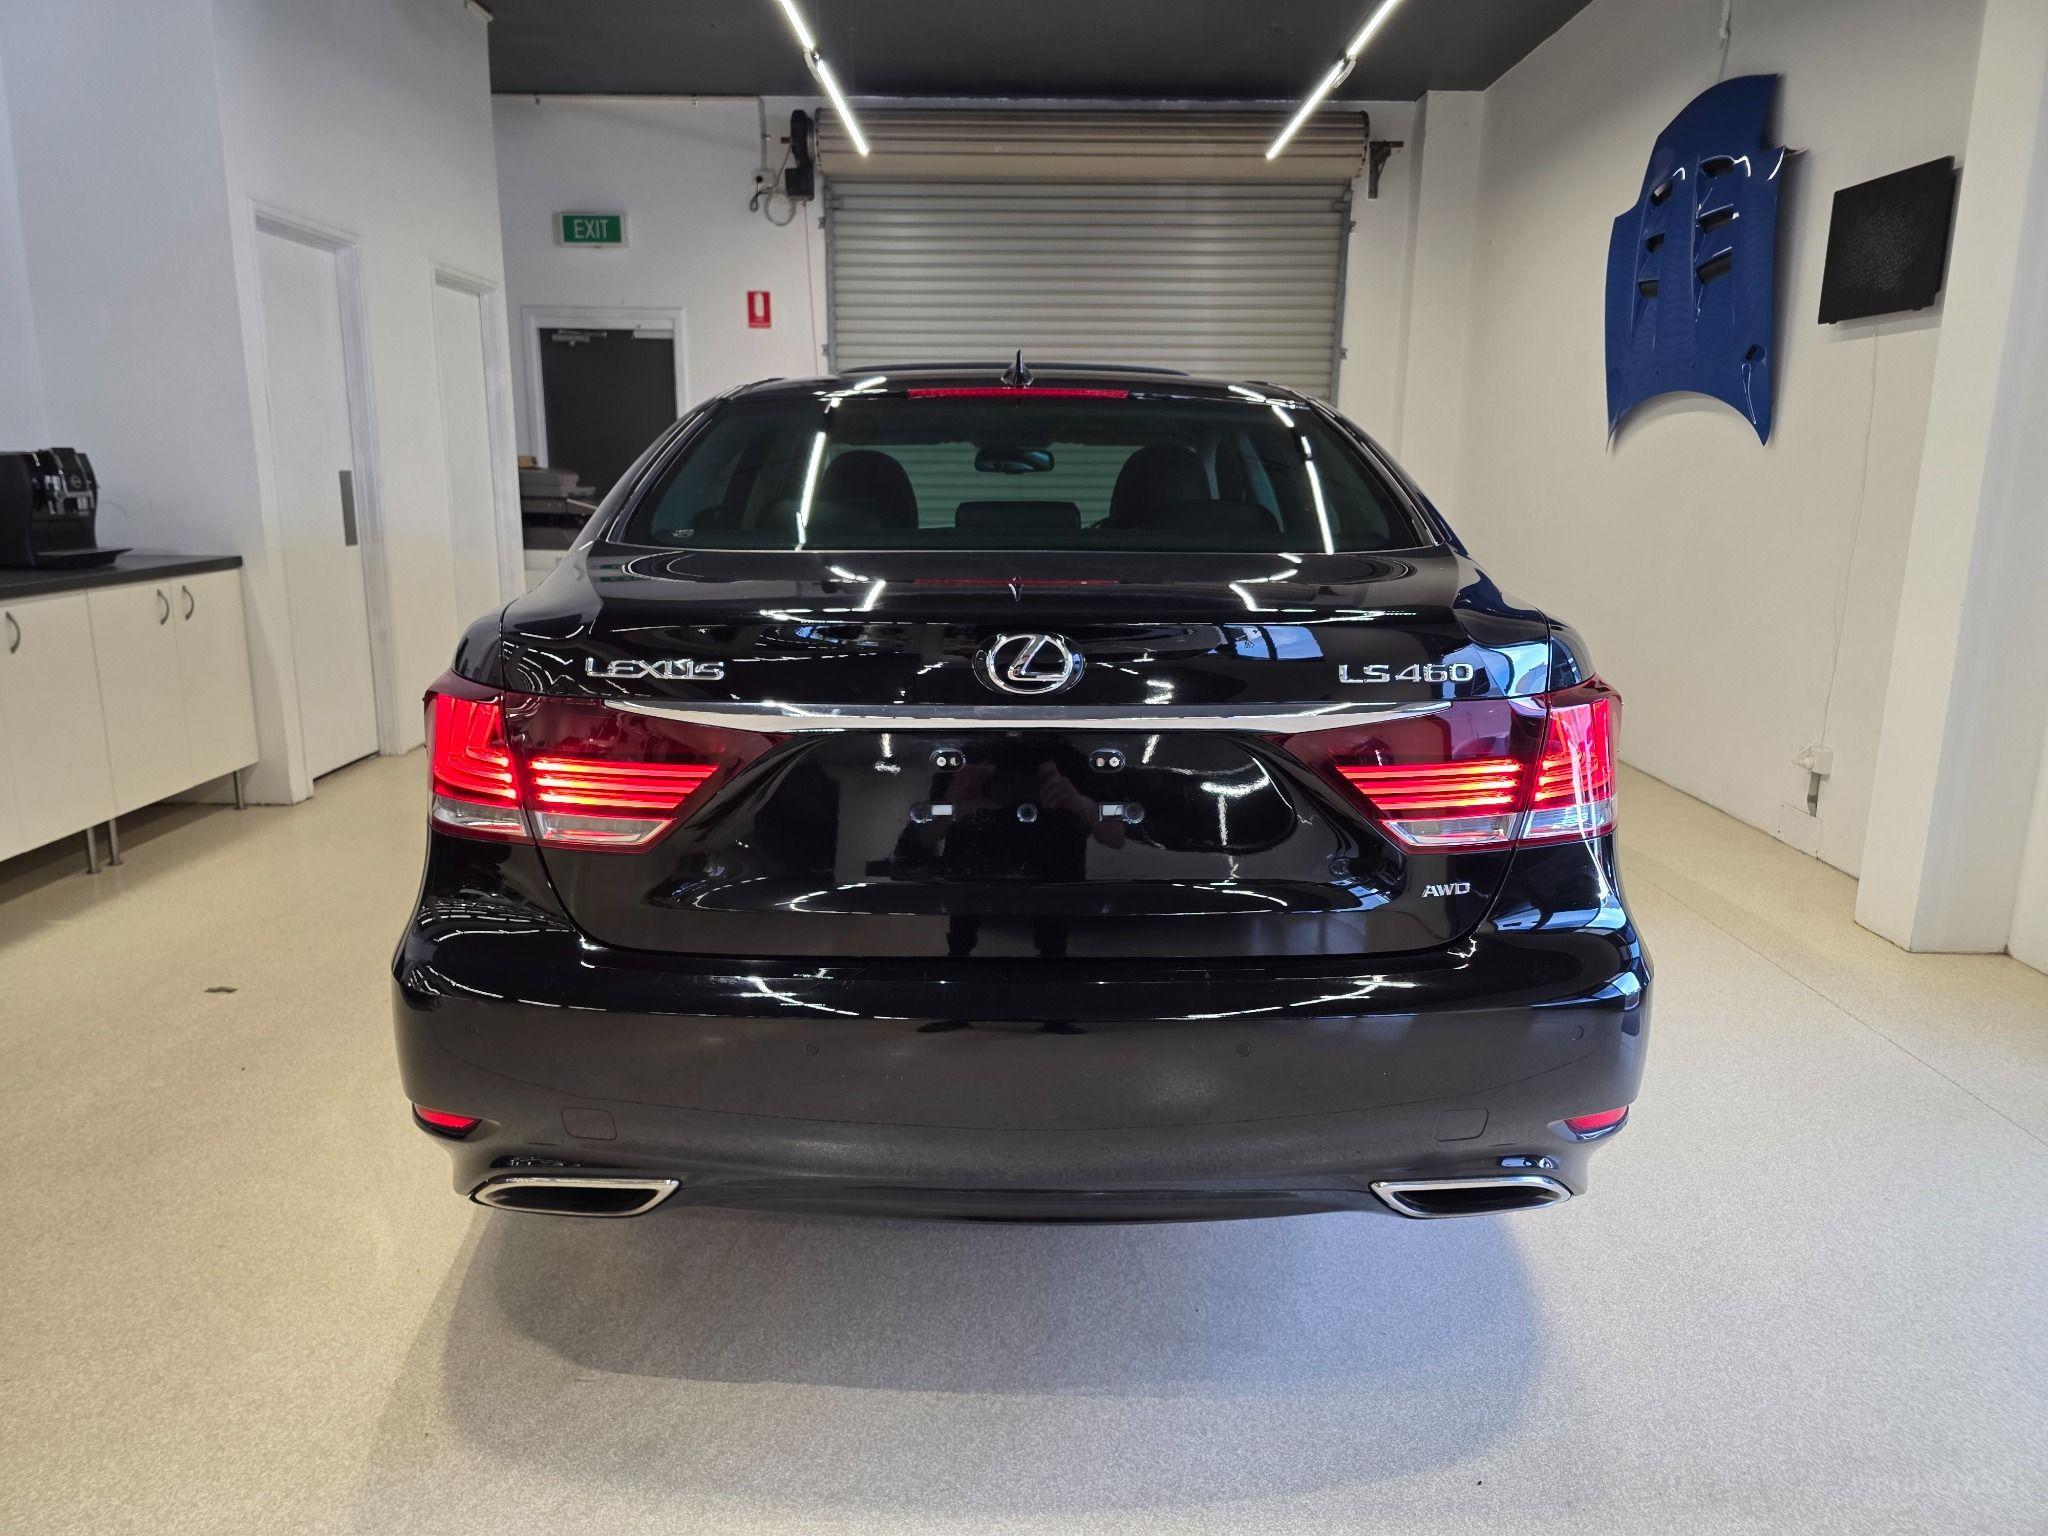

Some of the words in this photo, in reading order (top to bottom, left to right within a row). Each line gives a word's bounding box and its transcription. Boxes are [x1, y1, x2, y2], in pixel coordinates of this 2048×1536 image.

[574, 219, 608, 239] EXIT
[585, 657, 725, 680] LEXUS
[1395, 663, 1474, 683] 460
[1421, 882, 1471, 898] AWD
